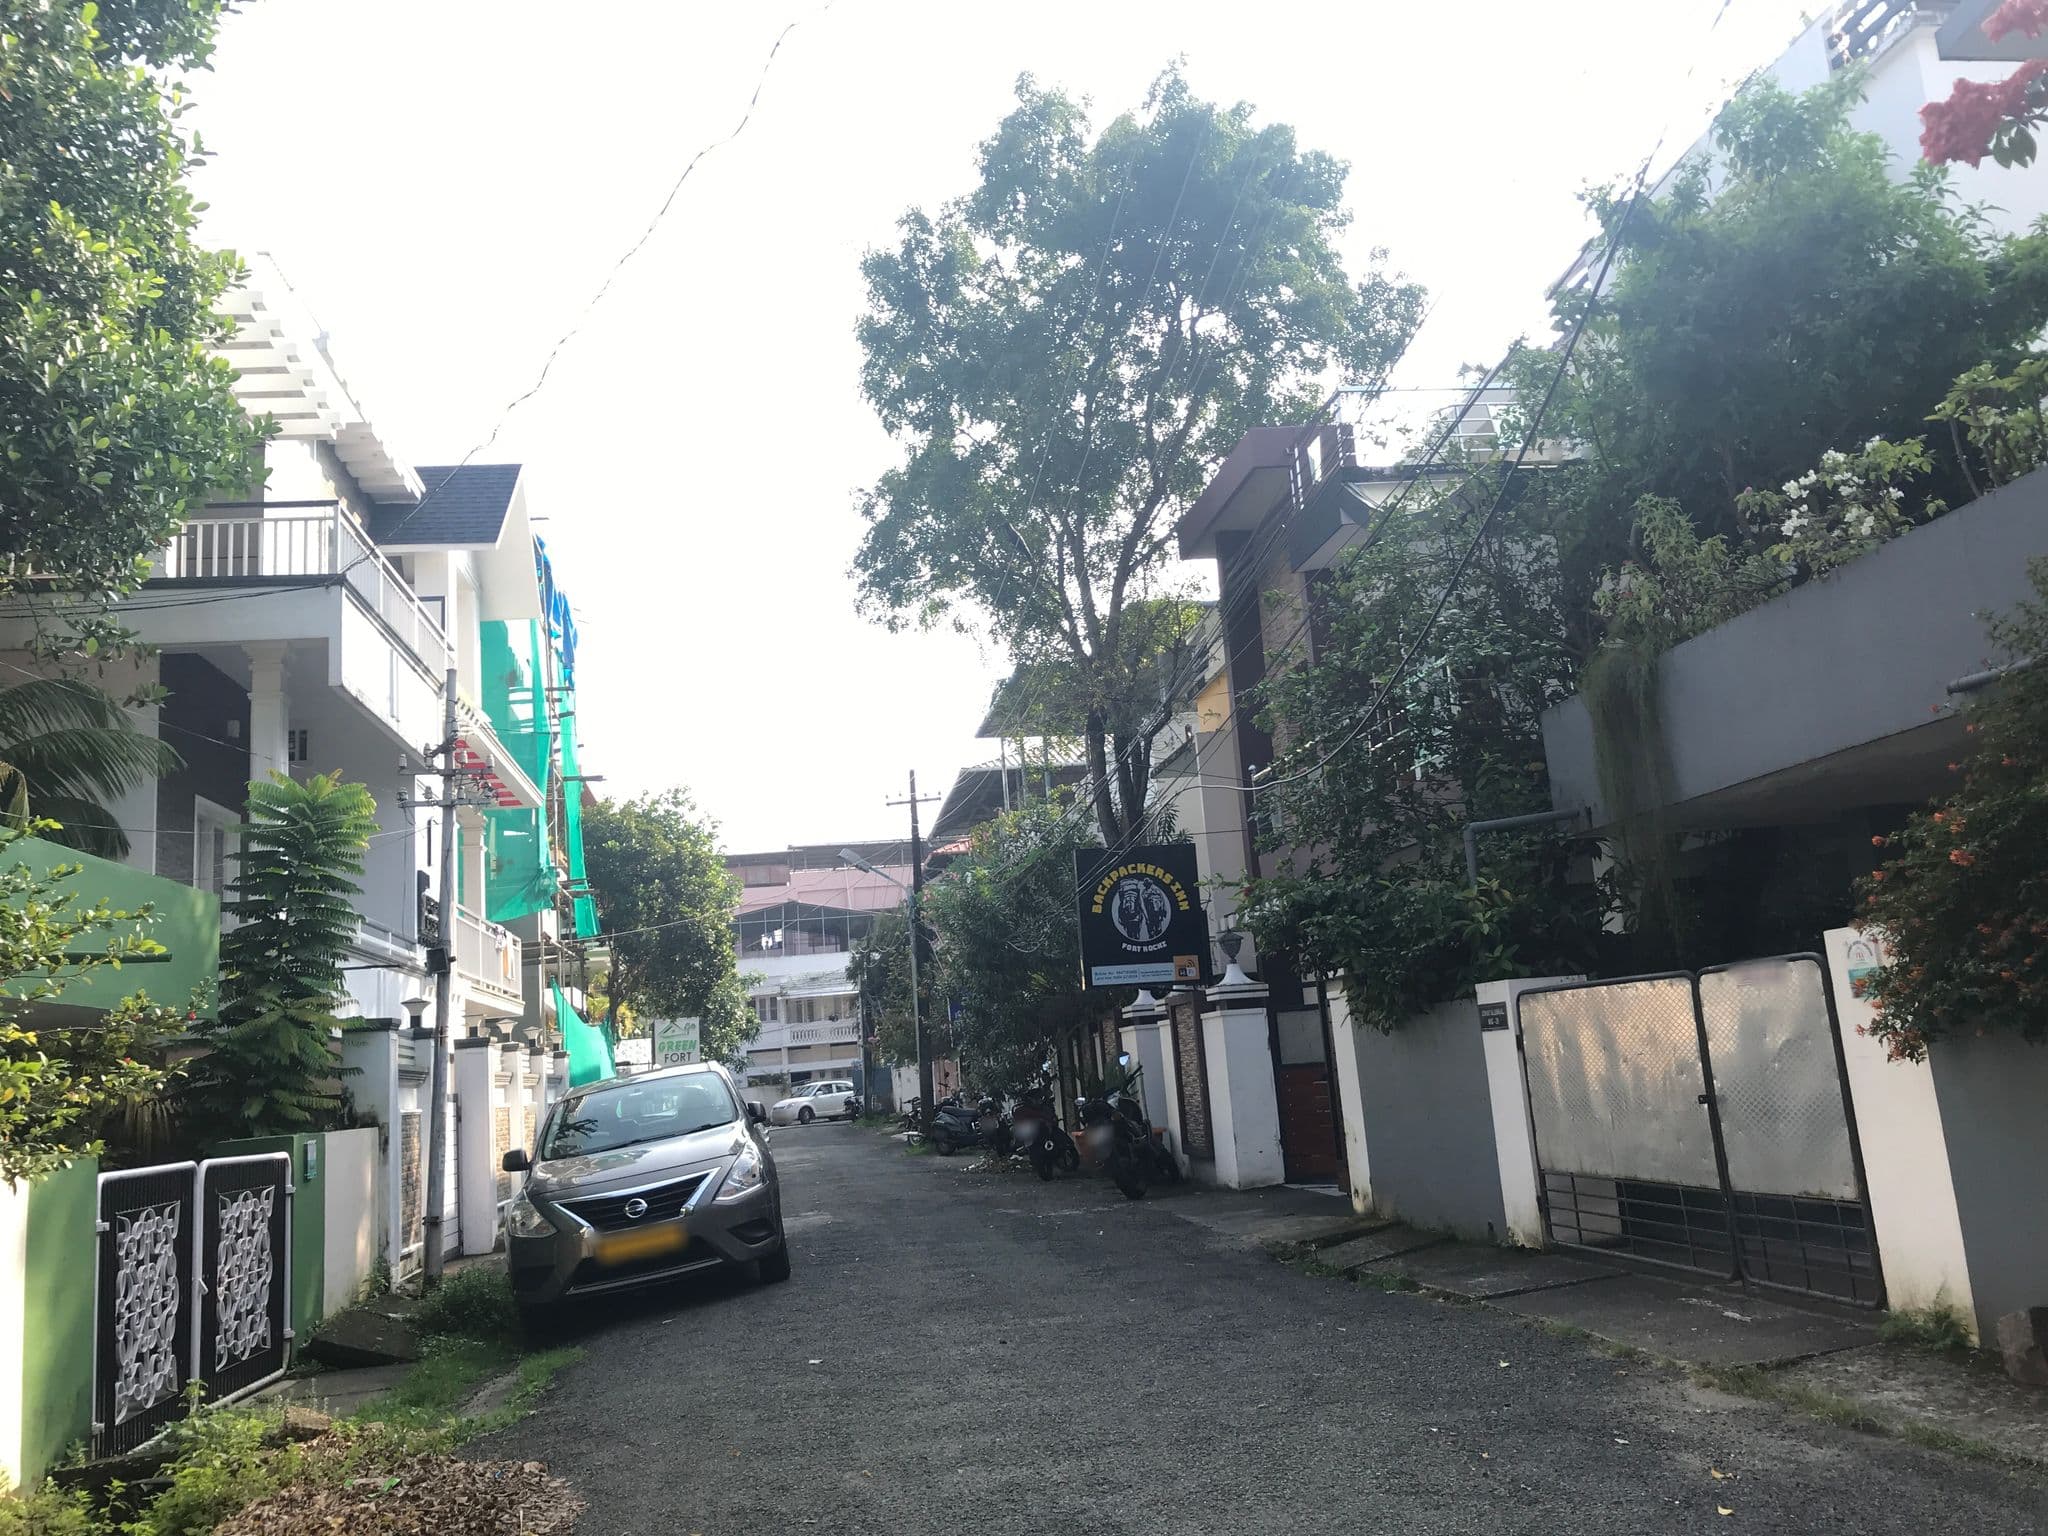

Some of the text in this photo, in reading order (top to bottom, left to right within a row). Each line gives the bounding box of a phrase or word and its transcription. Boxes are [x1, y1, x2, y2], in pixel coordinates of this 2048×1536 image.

[1092, 863, 1190, 914] BACKPACKERS INN
[1122, 943, 1141, 952] FORT
[658, 1039, 697, 1053] GREEN
[664, 1052, 692, 1064] FORT
